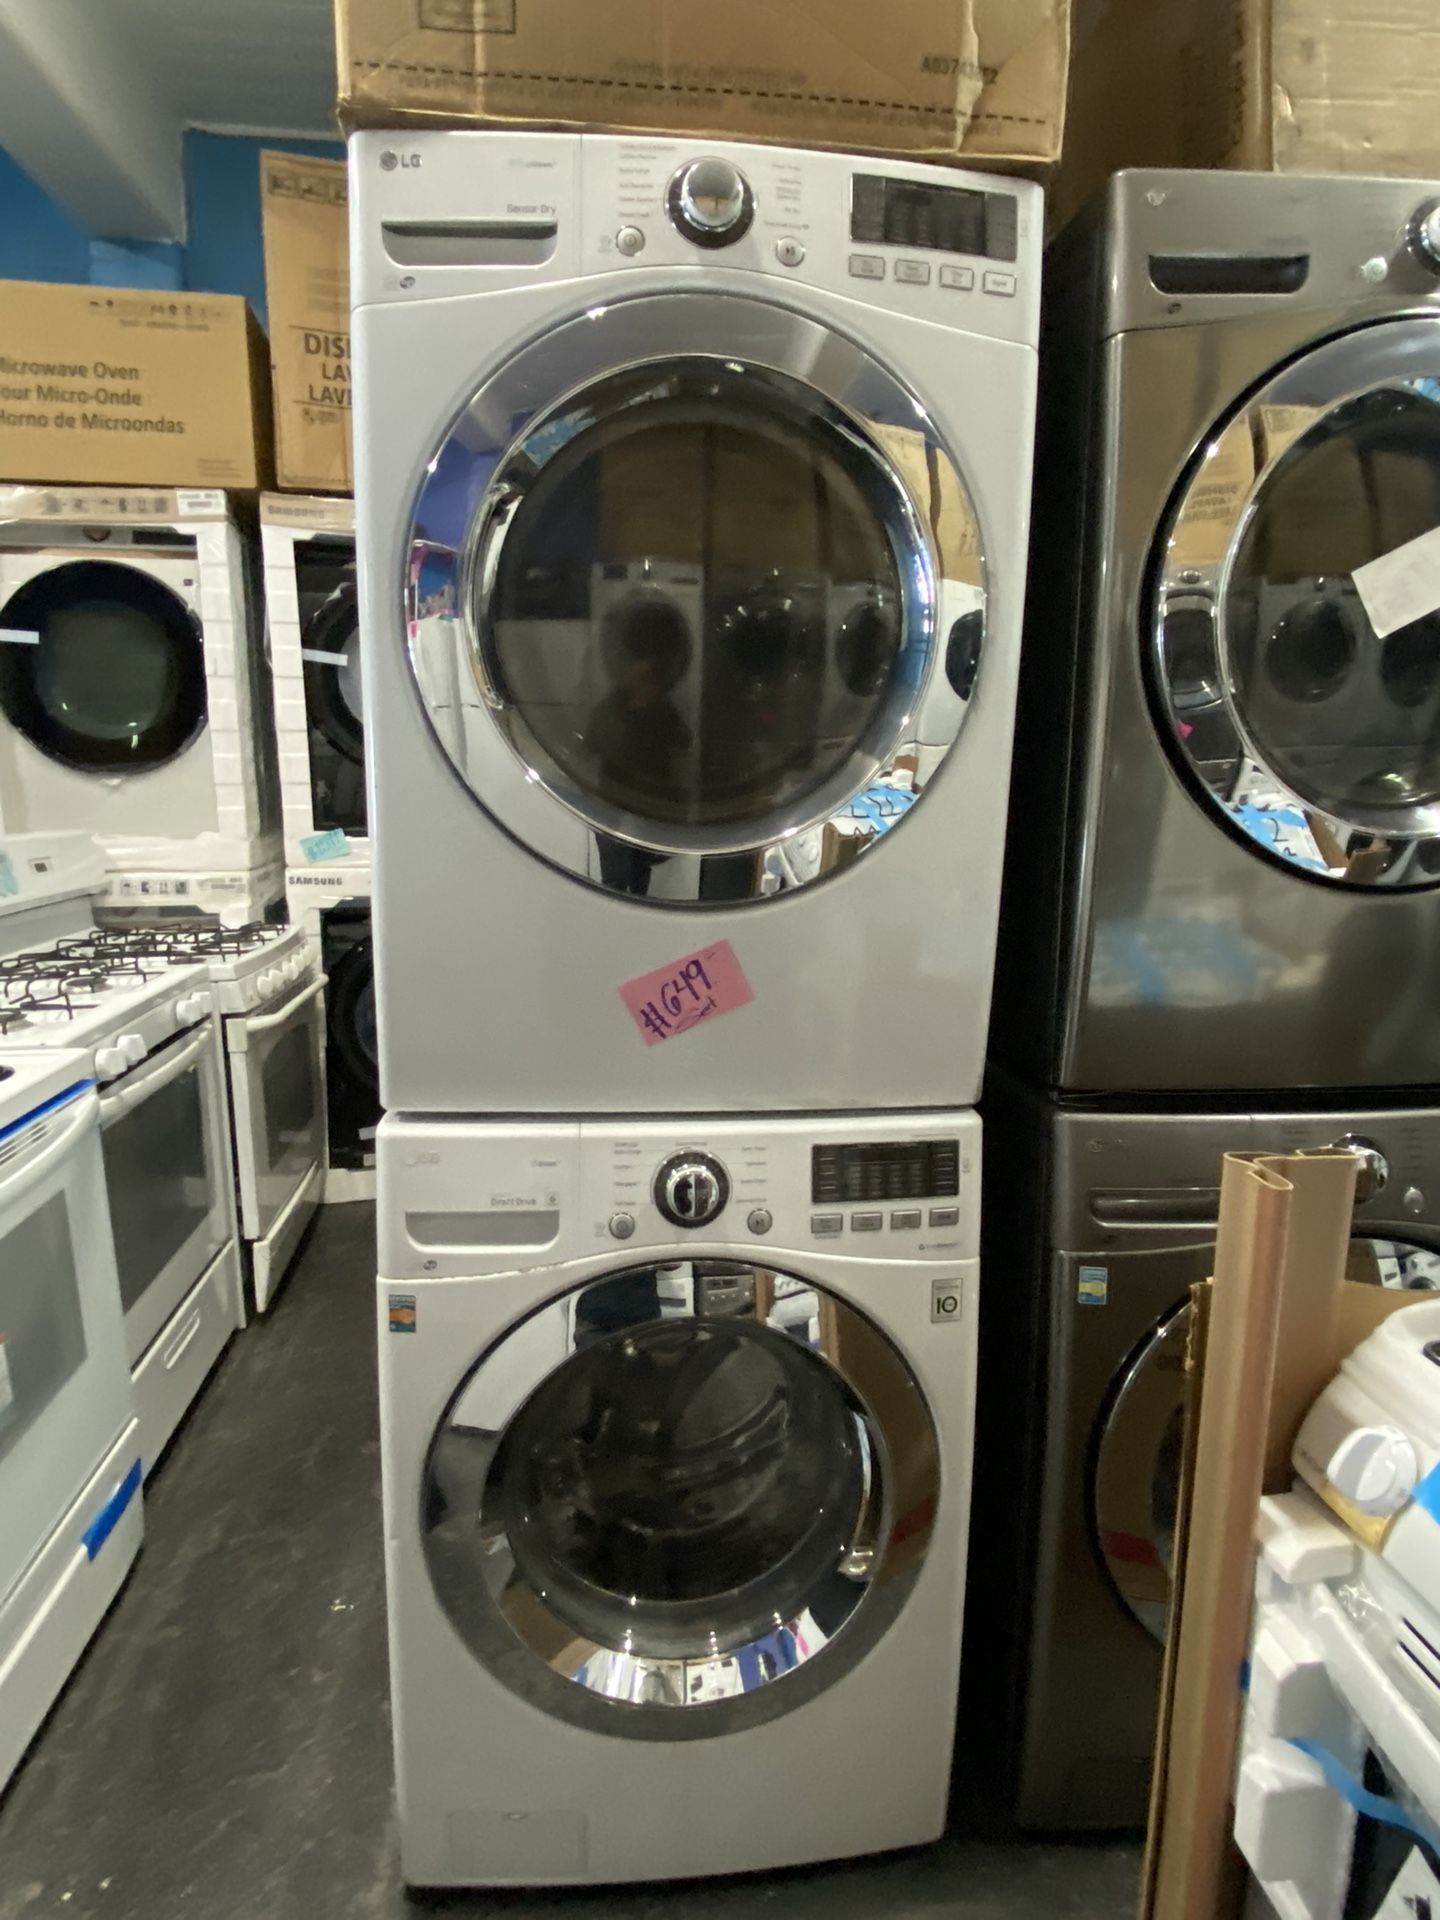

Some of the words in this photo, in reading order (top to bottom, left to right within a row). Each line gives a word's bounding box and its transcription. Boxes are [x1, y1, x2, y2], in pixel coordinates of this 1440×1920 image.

[401, 153, 422, 168] LG
[507, 203, 538, 213] Sensor
[541, 204, 556, 215] Dry
[93, 361, 140, 381] Oven
[0, 387, 32, 401] our
[37, 385, 142, 406] Micro-Onde
[54, 412, 75, 428] de
[82, 412, 185, 434] Microondas
[289, 876, 343, 886] SAMSUNG
[640, 959, 711, 1038] #649
